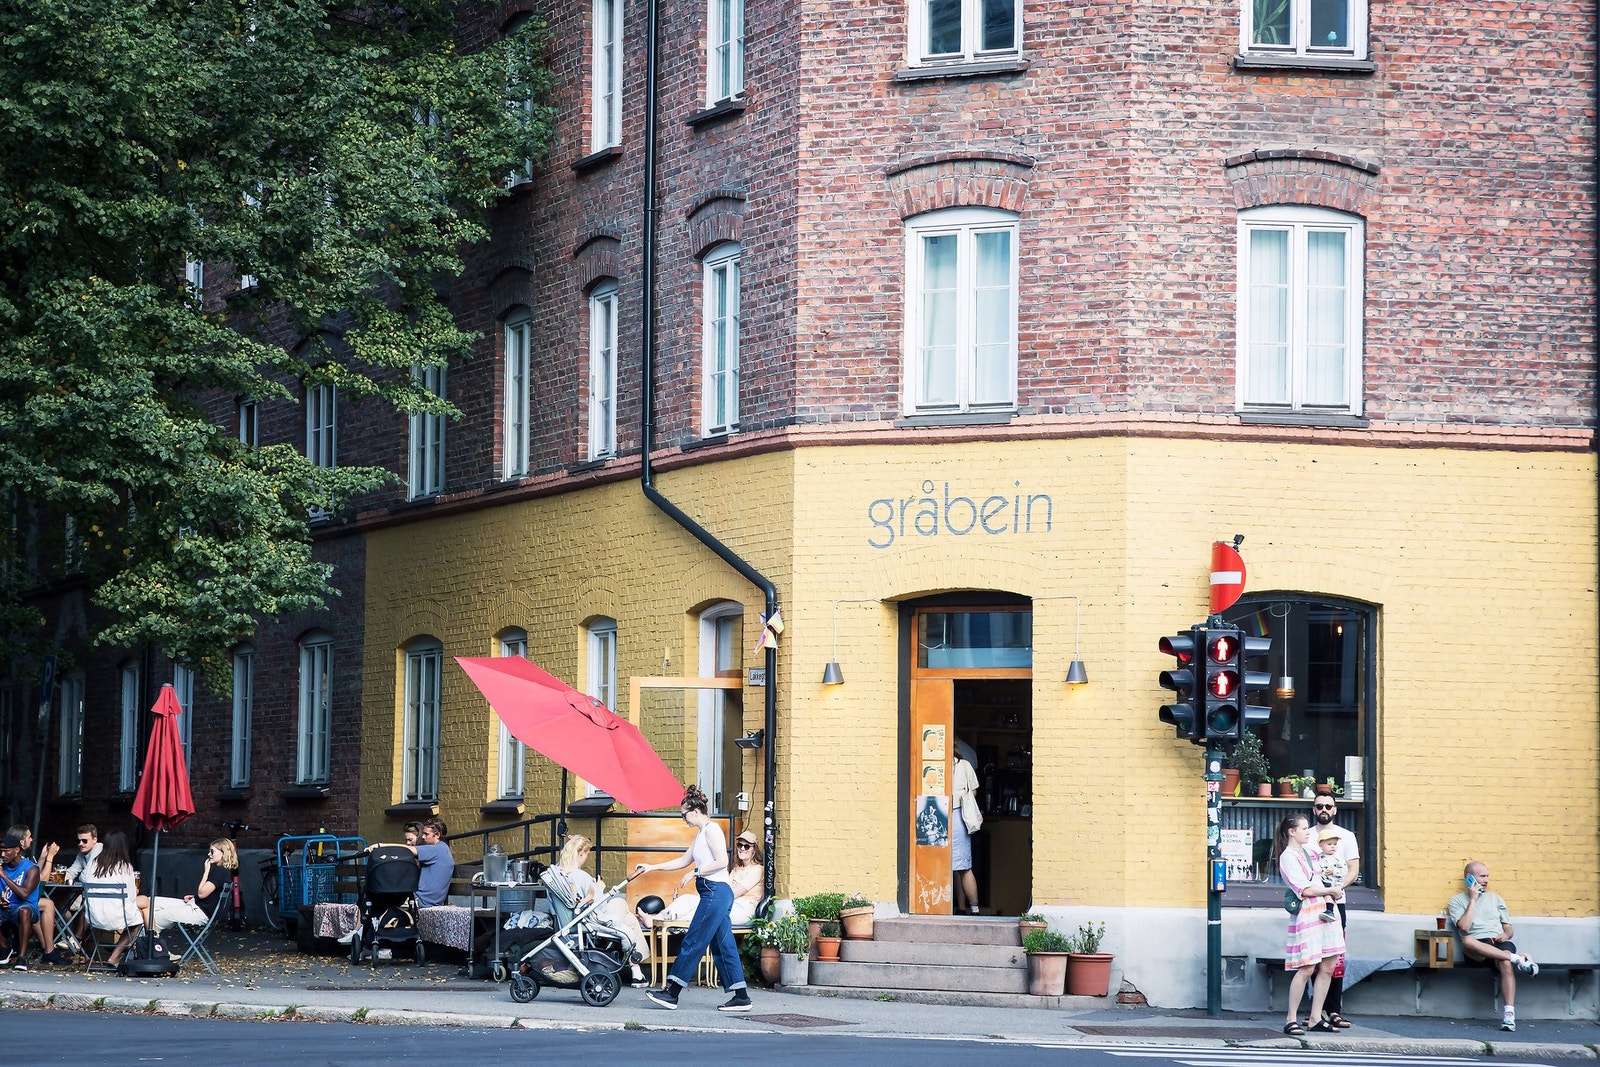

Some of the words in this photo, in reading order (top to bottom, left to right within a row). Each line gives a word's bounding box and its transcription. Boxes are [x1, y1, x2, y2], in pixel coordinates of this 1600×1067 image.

[868, 480, 1052, 549] gråbein
[43, 662, 52, 697] P
[750, 671, 766, 683] Lakkeg
